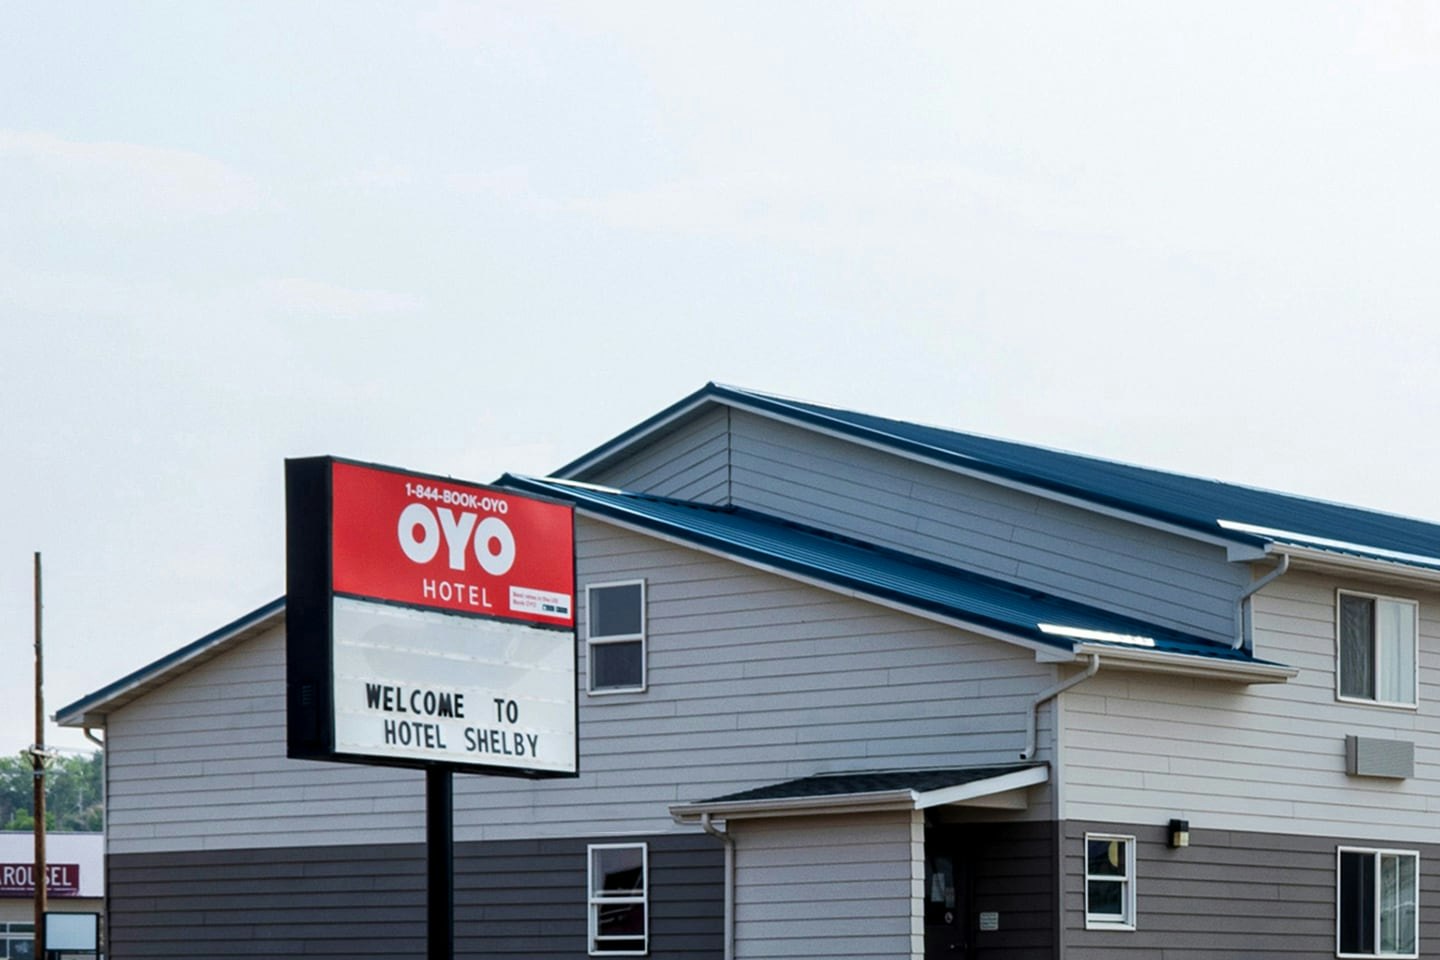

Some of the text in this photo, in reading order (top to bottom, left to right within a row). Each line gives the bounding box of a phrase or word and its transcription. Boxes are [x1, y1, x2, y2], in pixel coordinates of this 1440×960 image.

[405, 482, 508, 514] 1-844-BOOK-OYO
[397, 503, 516, 576] OYO
[423, 578, 492, 607] HOTEL
[366, 683, 518, 724] WELCOME TO
[384, 719, 538, 757] HOTEL SHELBY
